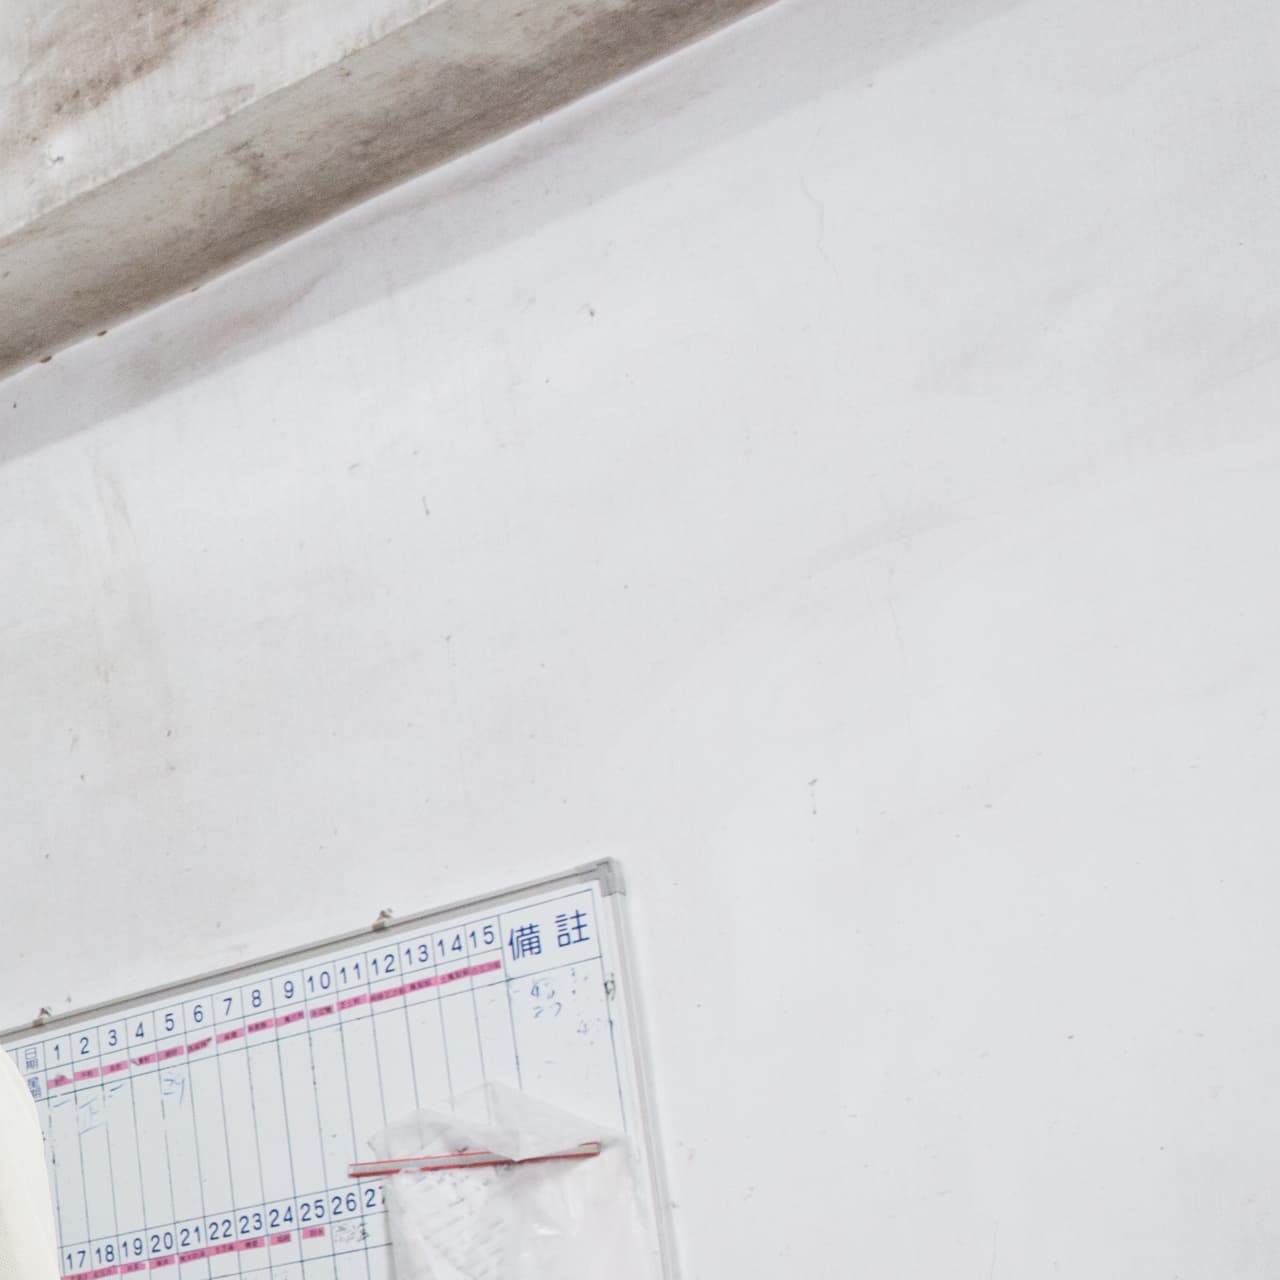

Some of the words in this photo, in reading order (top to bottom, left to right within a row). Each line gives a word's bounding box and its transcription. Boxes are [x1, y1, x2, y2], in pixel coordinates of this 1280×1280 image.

[507, 909, 591, 961] 備註
[53, 1044, 61, 1062] 1
[79, 1036, 90, 1056] 2
[107, 1028, 119, 1047] 3
[134, 1021, 146, 1040] 4
[164, 1013, 176, 1032] 5
[193, 1004, 205, 1023] 6
[222, 997, 234, 1017] 7
[251, 989, 263, 1008] 8
[282, 980, 295, 1000] 9
[307, 971, 332, 993] 10
[340, 963, 362, 985] 11
[371, 953, 396, 976] 12
[405, 944, 430, 966] 13
[437, 934, 463, 957] 14
[469, 925, 495, 949] 15
[65, 1251, 87, 1270] 17
[95, 1244, 115, 1264] 18
[122, 1237, 143, 1257] 19
[151, 1231, 174, 1254] 20
[180, 1225, 202, 1247] 21
[209, 1218, 233, 1241] 22
[239, 1212, 264, 1235] 23
[269, 1205, 294, 1228] 24
[300, 1199, 326, 1222] 25
[331, 1192, 357, 1216] 26
